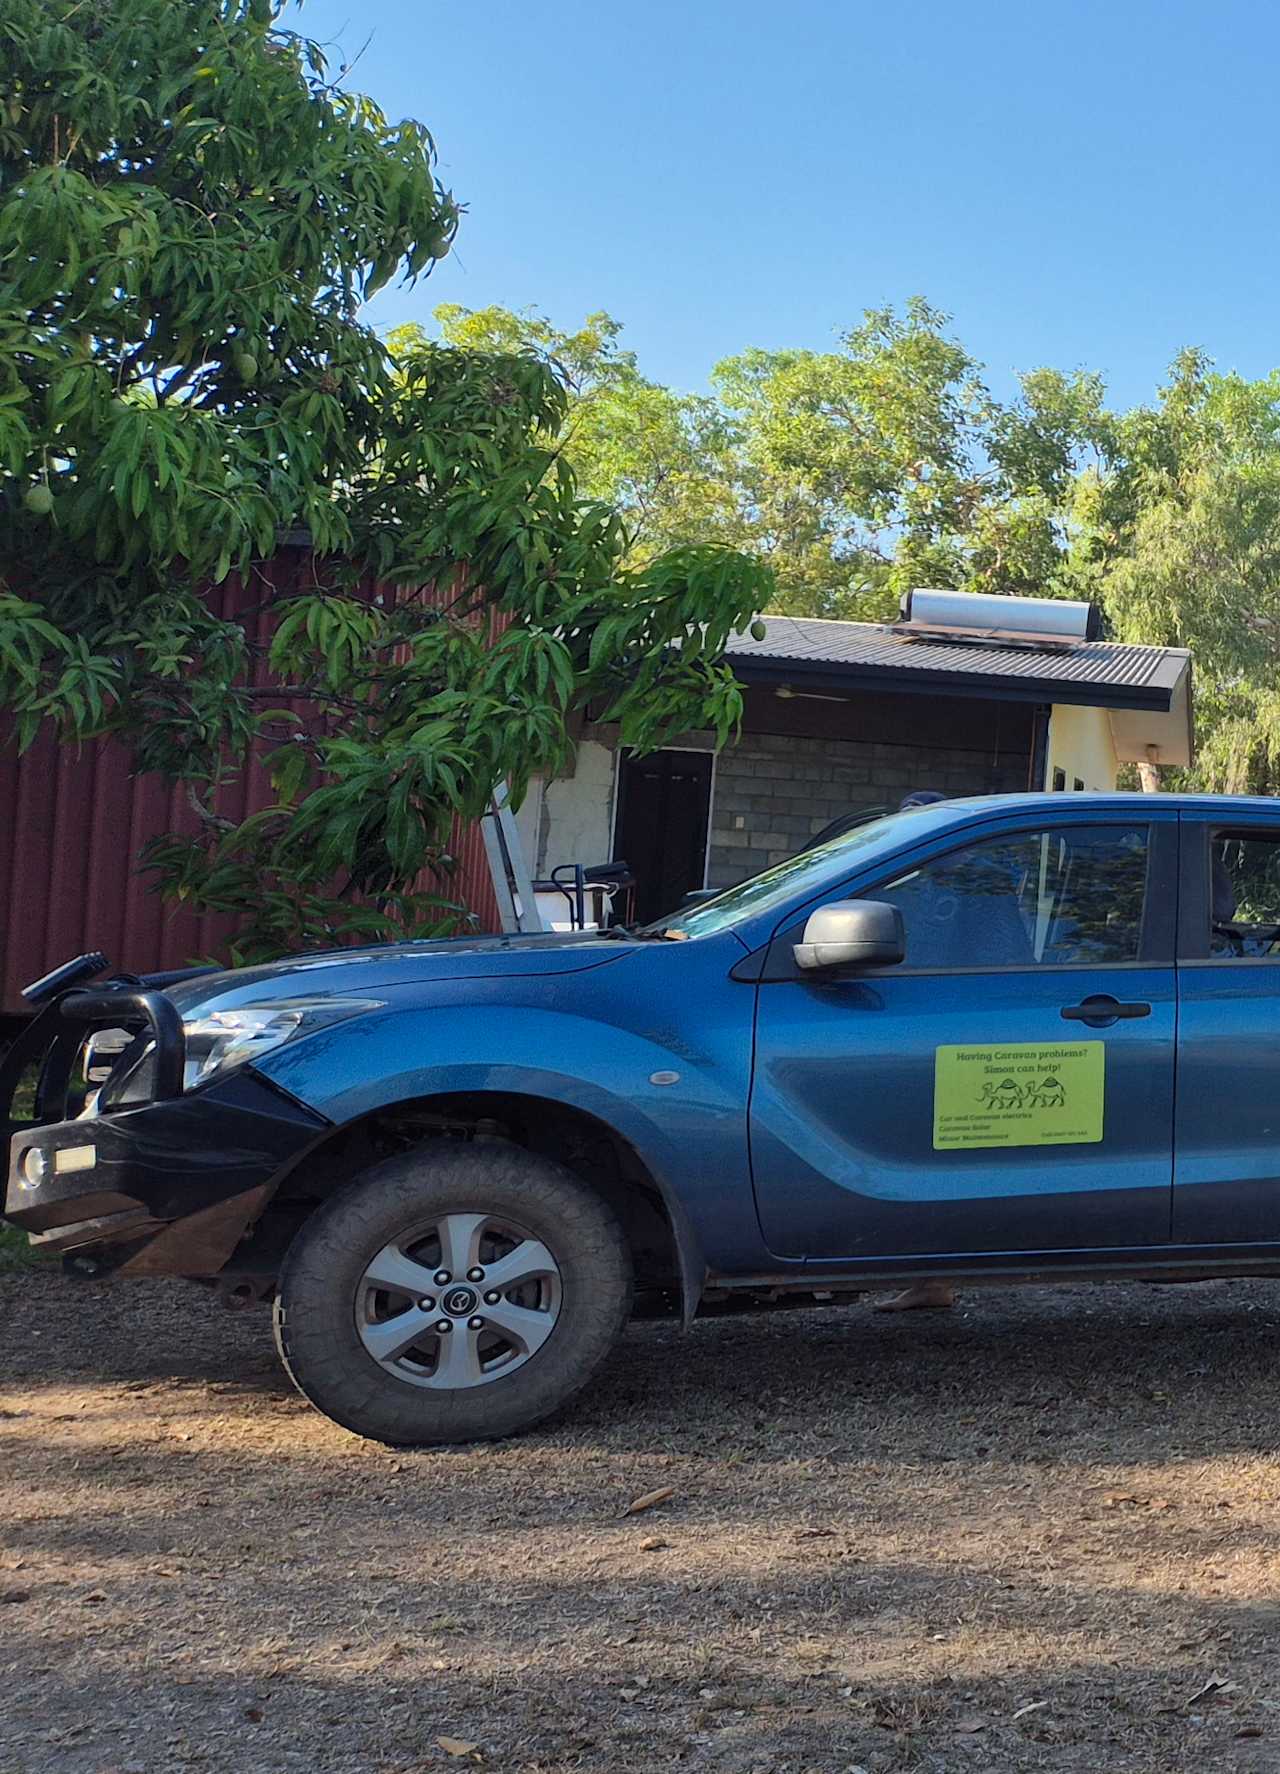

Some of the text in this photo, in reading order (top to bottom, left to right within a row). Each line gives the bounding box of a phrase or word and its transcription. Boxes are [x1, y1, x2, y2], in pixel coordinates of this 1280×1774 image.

[956, 1048, 1088, 1062] Having Caravan problems?
[984, 1062, 1061, 1074] Simon can help!
